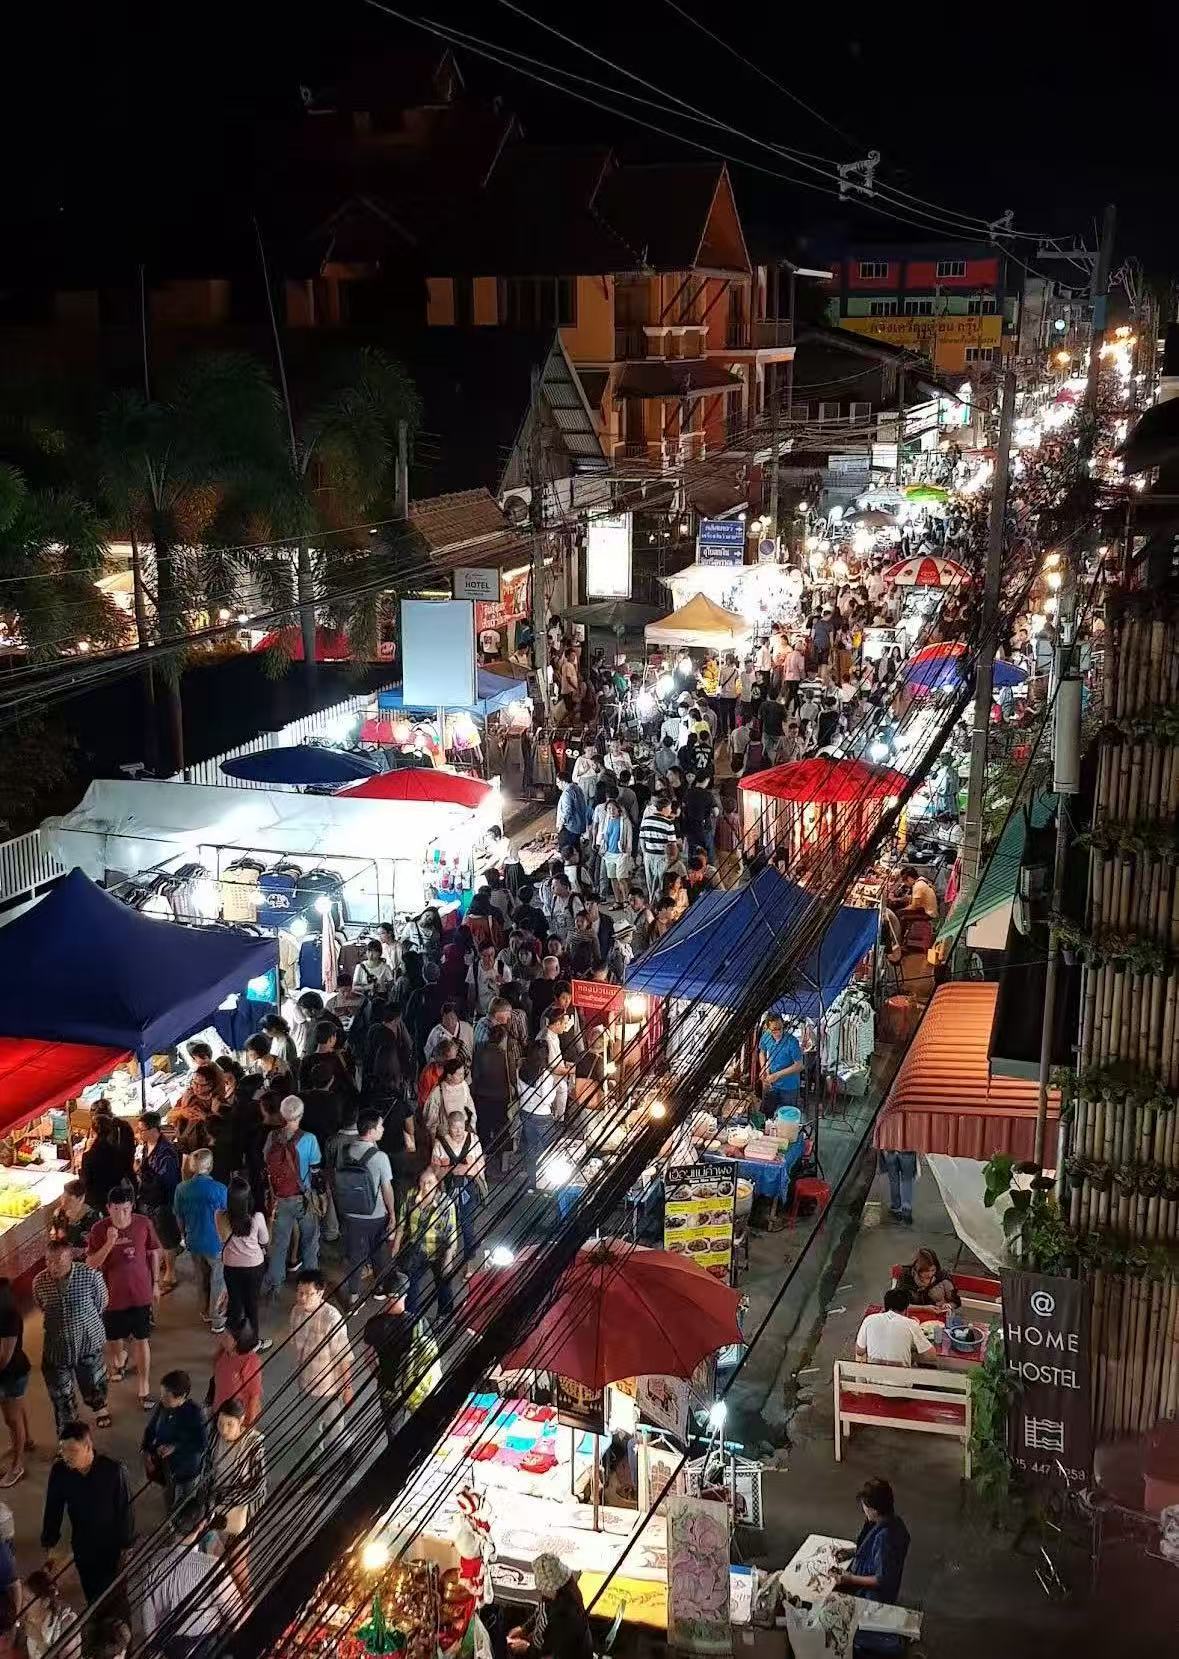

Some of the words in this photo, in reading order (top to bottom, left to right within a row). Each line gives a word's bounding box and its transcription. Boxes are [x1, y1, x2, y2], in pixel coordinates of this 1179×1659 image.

[465, 581, 490, 589] HOTEL
[1030, 1290, 1056, 1317] @
[1008, 1323, 1080, 1353] HOME
[1009, 1359, 1081, 1390] HOSTEL
